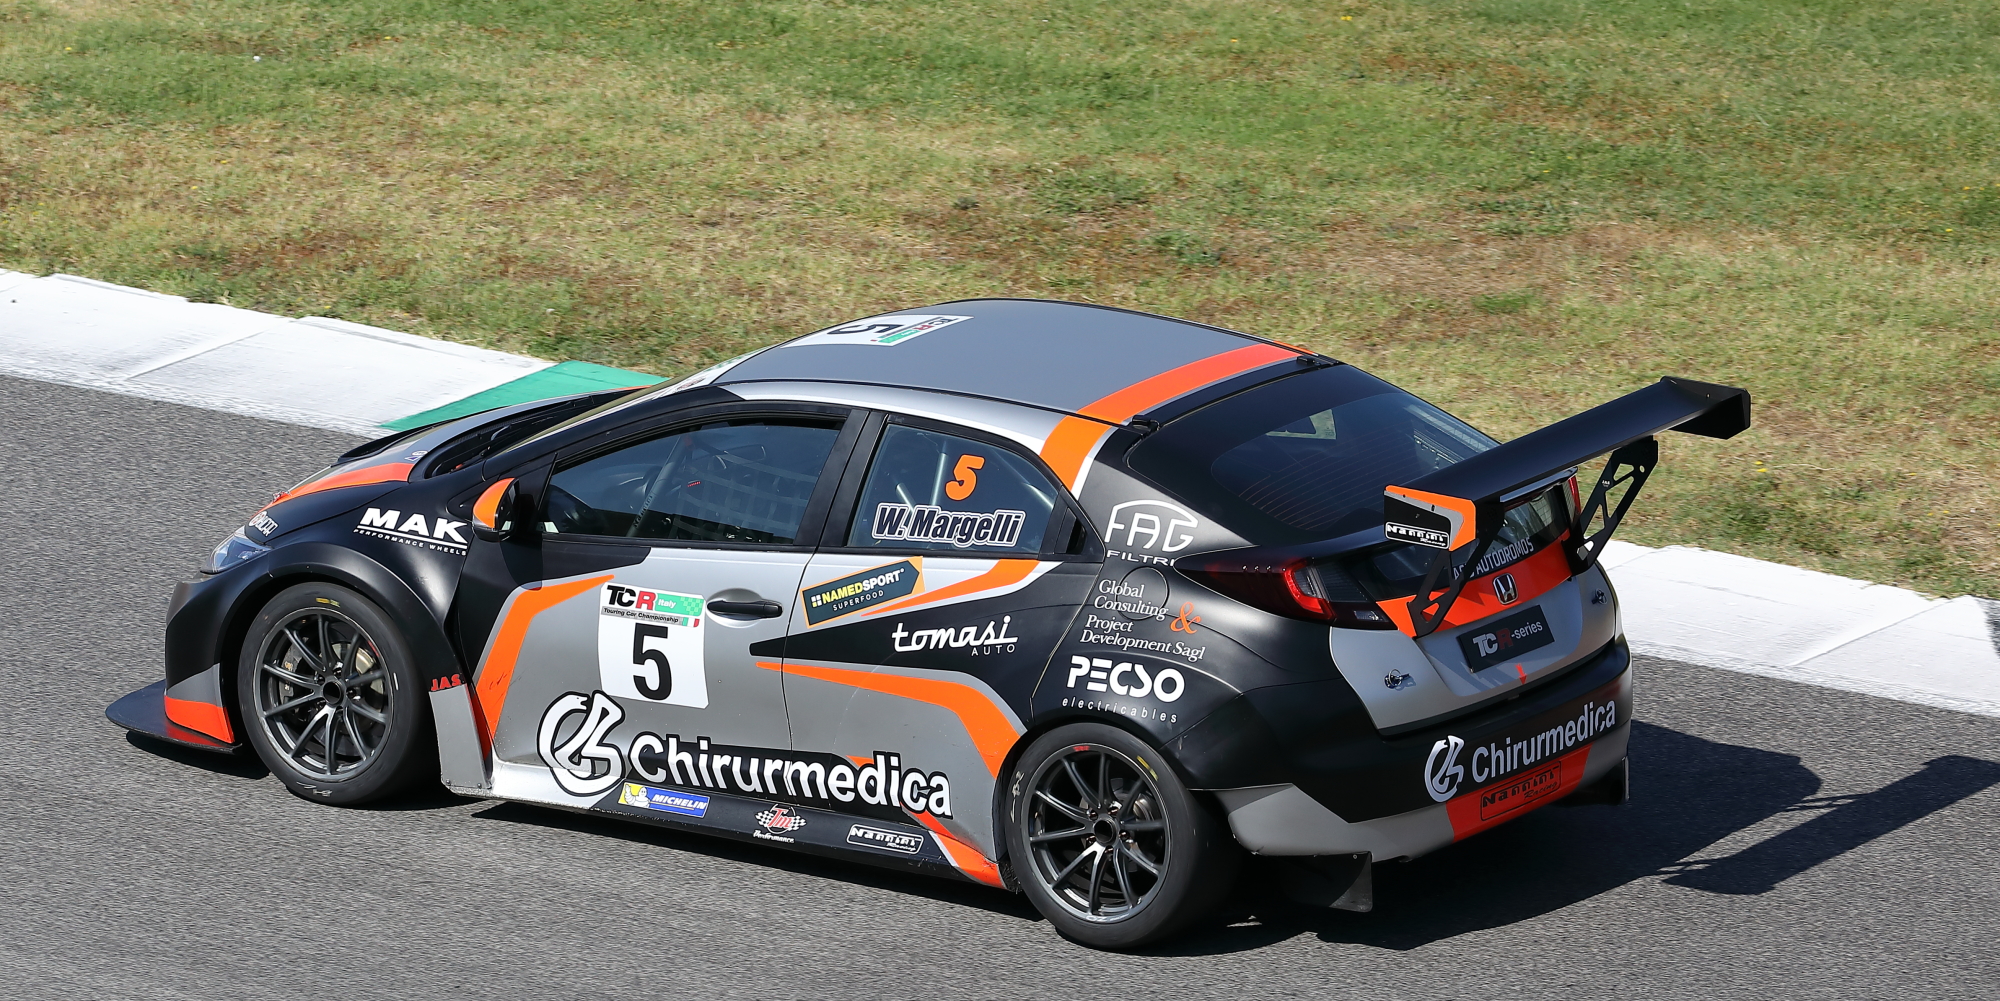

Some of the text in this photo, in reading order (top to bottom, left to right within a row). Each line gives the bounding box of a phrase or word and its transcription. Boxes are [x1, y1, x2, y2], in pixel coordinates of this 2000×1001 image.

[827, 324, 904, 335] 5
[945, 454, 985, 501] 5
[360, 507, 468, 544] MAK
[873, 503, 1026, 546] W. Margelli
[1105, 499, 1198, 552] FAG
[353, 528, 467, 556] PERFORMANCE WHEELS
[1476, 537, 1534, 575] AUTODROMOS
[1107, 550, 1174, 567] FILTRI
[607, 585, 676, 610] TCR Italy
[833, 590, 884, 611] SUPERFOOD
[1099, 579, 1145, 598] Global
[604, 608, 625, 616] Touring
[638, 612, 678, 623] Championship
[1085, 614, 1133, 633] Project
[1094, 595, 1202, 634] Consulting &
[892, 615, 1018, 652] tomasi
[971, 643, 1016, 656] AUTO
[1080, 630, 1206, 662] Development Sagl
[633, 622, 672, 701] 5
[431, 674, 461, 691] JAS
[1067, 655, 1185, 702] PECSO
[1062, 697, 1177, 723] electricables
[1472, 700, 1616, 783] Chirurmedica
[629, 734, 952, 817] Chirurmedica
[1482, 765, 1559, 807] Nannini
[652, 794, 708, 810] MICHELIN
